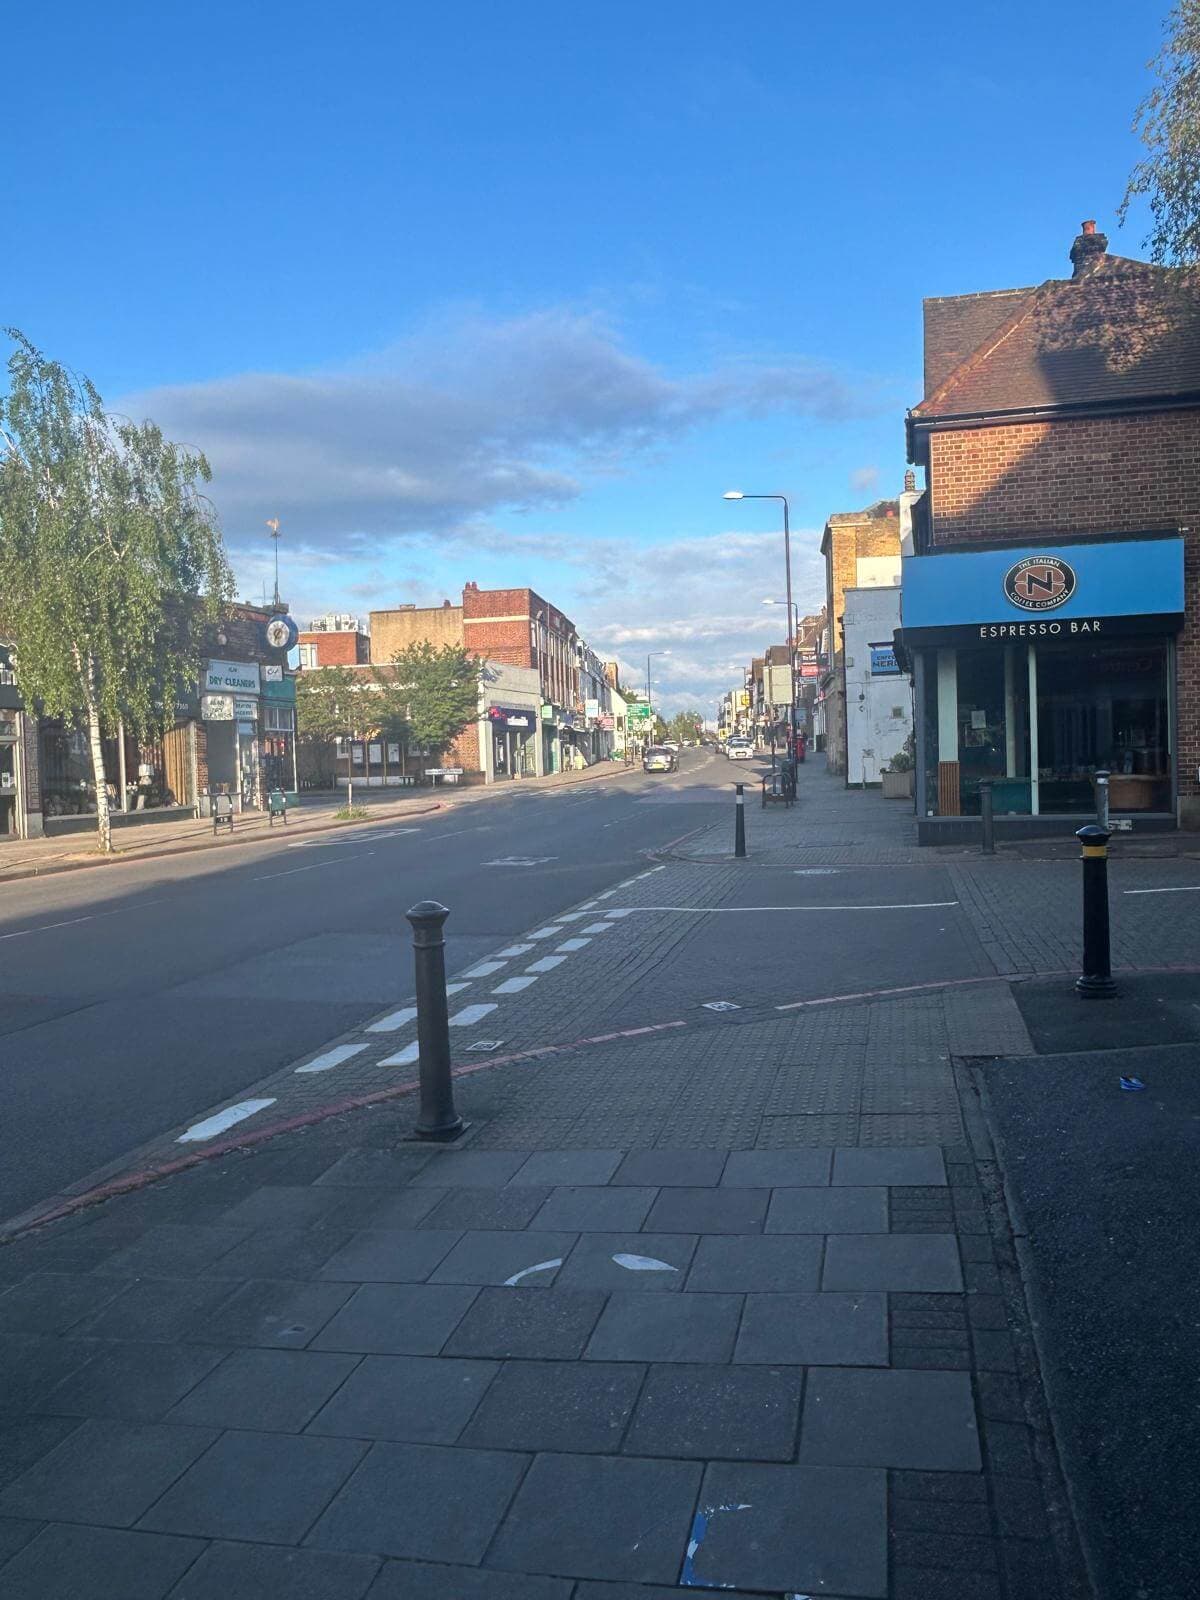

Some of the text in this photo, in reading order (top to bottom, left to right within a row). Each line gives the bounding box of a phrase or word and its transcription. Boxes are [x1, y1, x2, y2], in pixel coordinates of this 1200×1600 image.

[1019, 557, 1060, 570] THE ITALIAN
[1027, 571, 1053, 595] N
[1035, 588, 1070, 608] COMPANY
[980, 620, 1101, 638] ESPRESSO BAR
[209, 675, 256, 689] DRY CLEANERS
